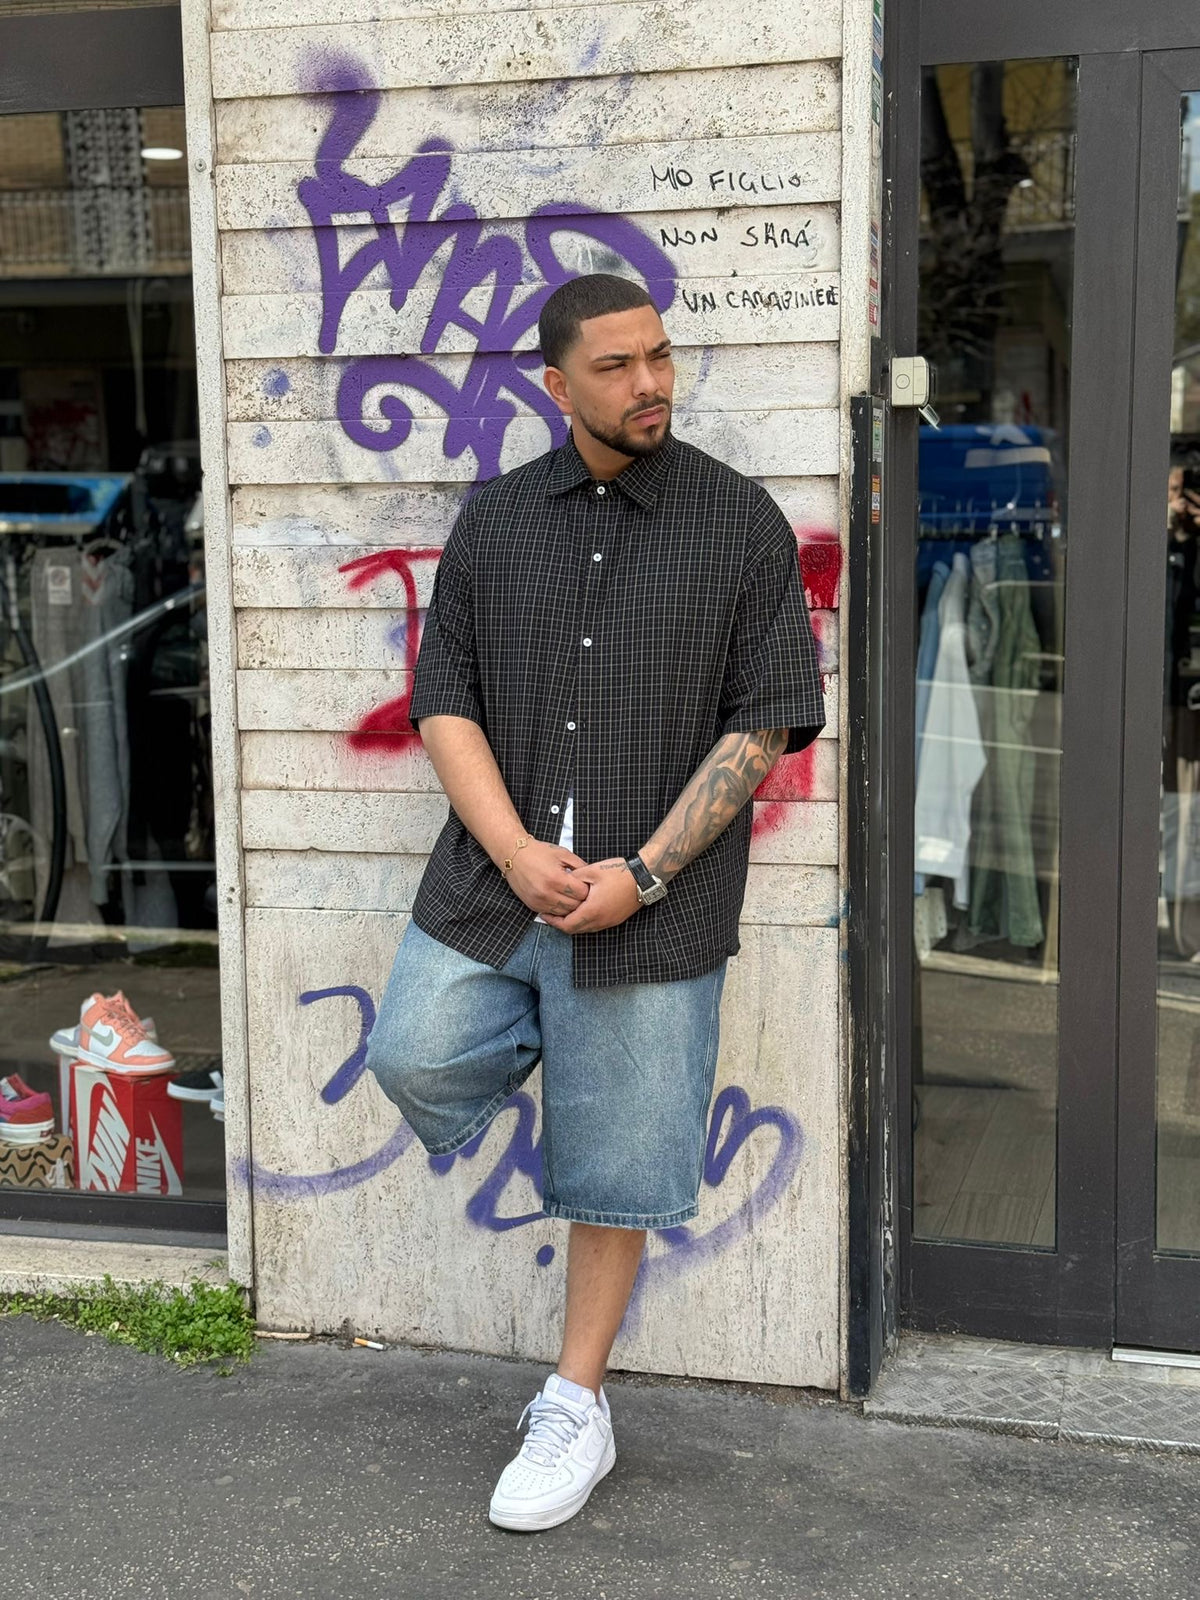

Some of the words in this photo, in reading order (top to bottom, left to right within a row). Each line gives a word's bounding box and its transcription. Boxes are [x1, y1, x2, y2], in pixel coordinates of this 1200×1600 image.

[650, 163, 693, 191] MIO
[709, 170, 801, 194] FIGLIO
[660, 226, 718, 248] NON
[682, 288, 716, 314] UN
[135, 1137, 162, 1194] NIKE
